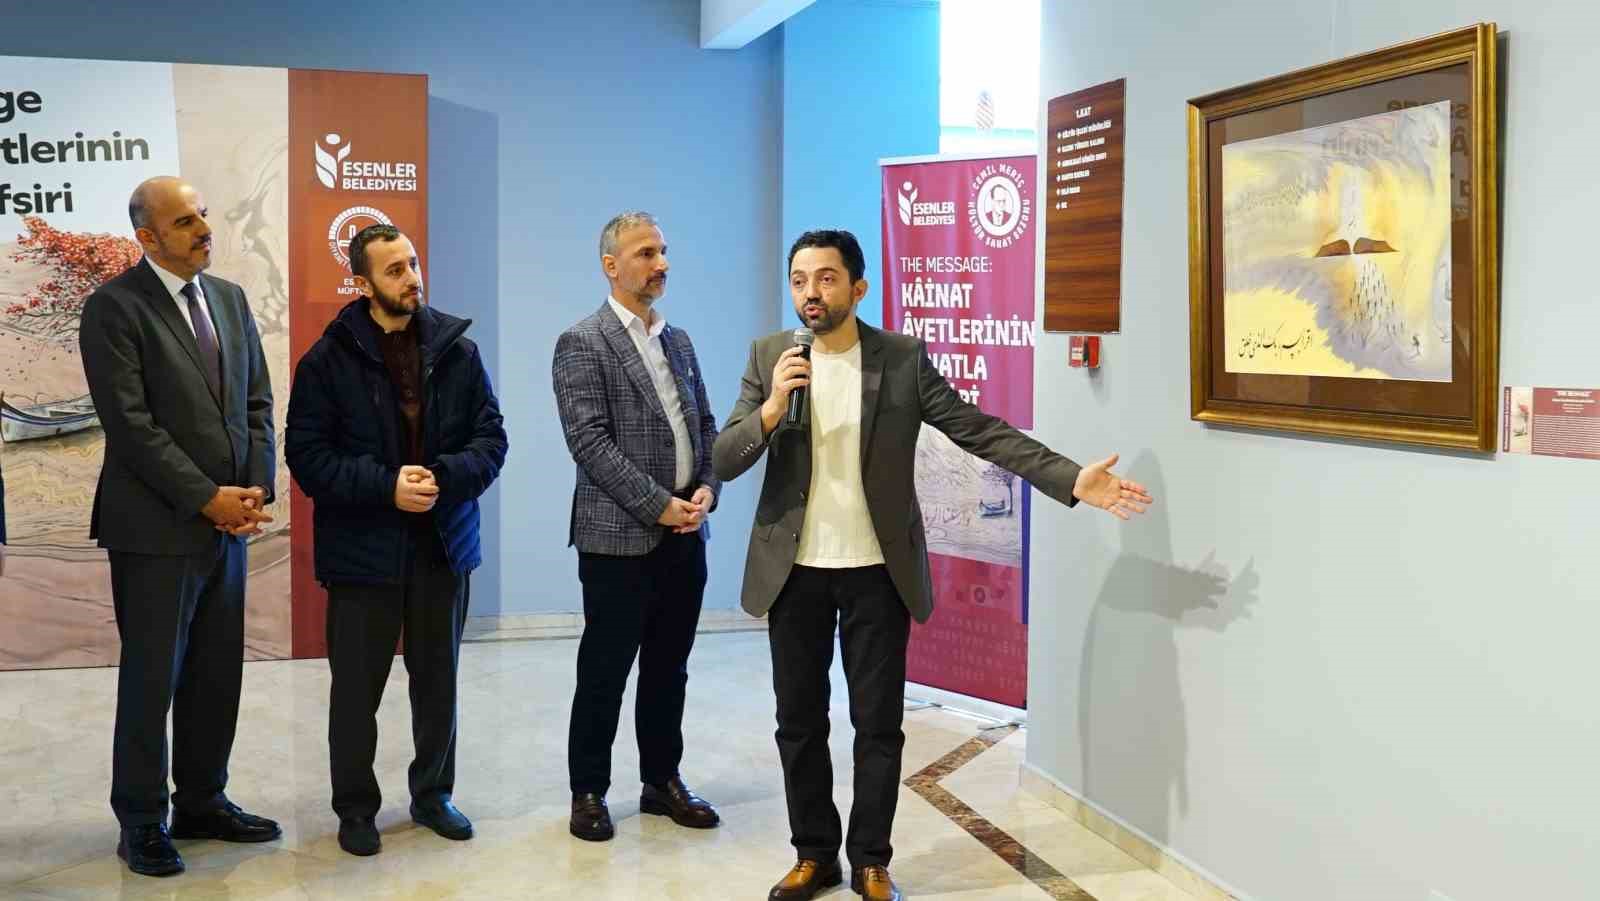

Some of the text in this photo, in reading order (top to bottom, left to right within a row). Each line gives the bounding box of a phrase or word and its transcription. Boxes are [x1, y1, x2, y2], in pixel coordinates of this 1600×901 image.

[0, 131, 149, 165] tlerinin
[342, 161, 417, 178] ESENLER
[0, 182, 74, 215] fsiri
[912, 201, 955, 215] ESENLER
[900, 256, 993, 273] THE MESSAGE:
[901, 276, 973, 309] KÂİNAT
[902, 310, 1036, 347] ÂYETLERİNİN
